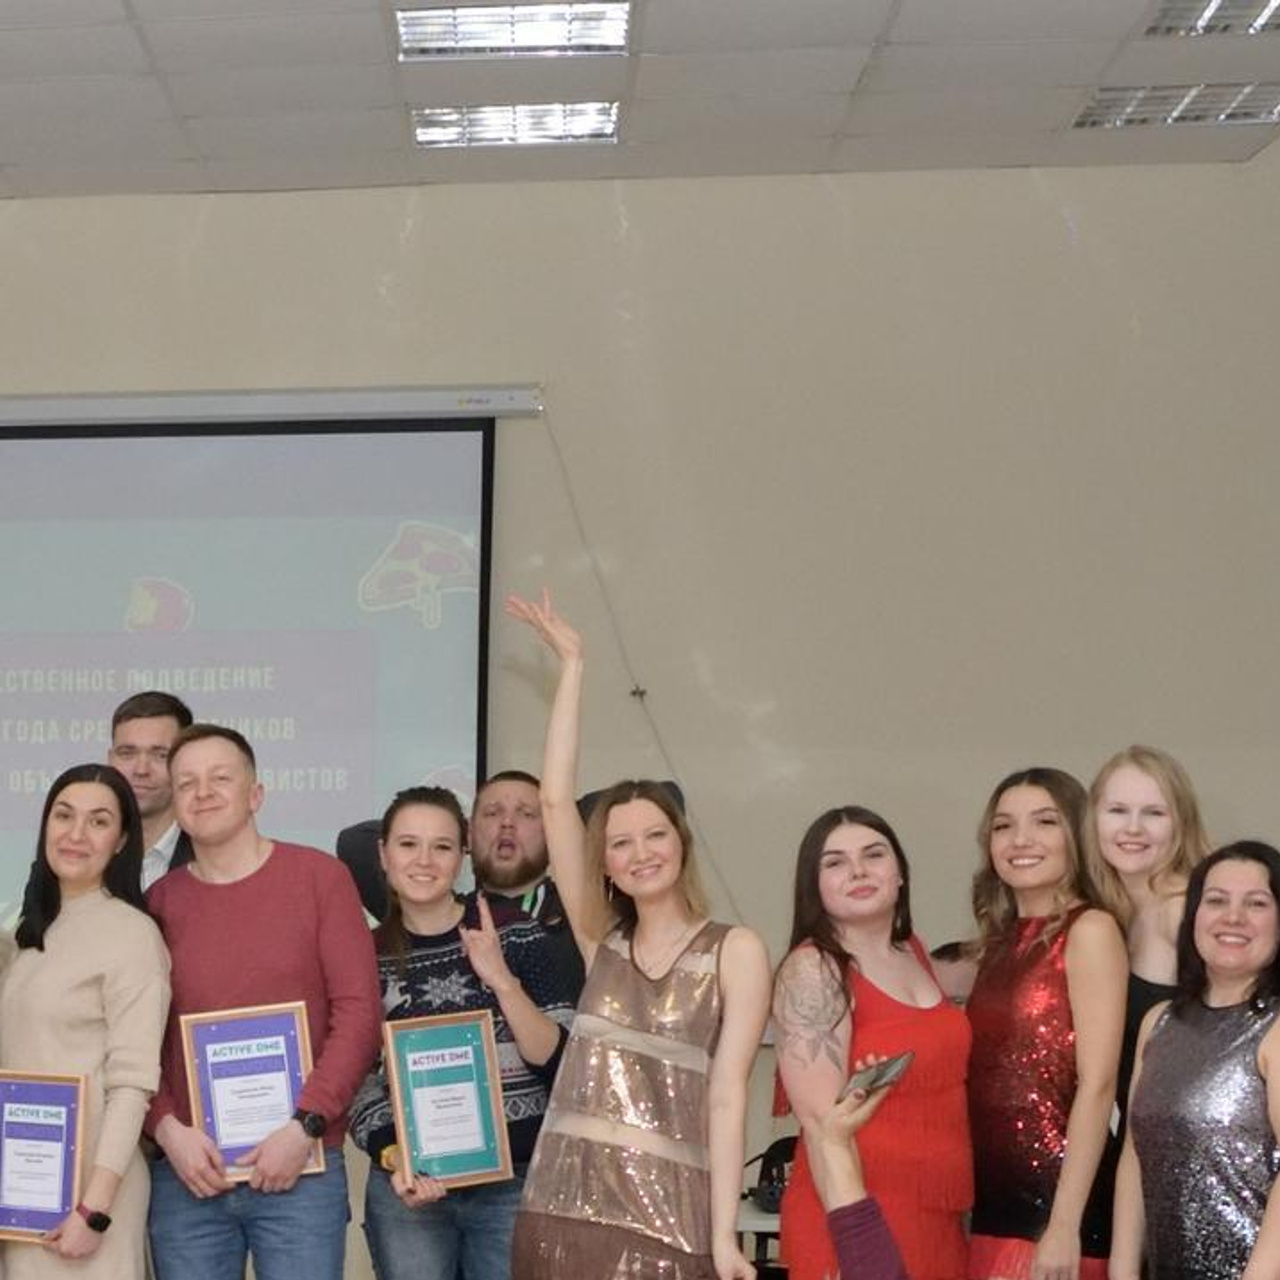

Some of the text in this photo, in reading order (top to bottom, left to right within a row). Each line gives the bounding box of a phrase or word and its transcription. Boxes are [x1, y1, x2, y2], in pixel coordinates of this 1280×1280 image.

[127, 666, 275, 690] ПОДВЕДЕНИЕ
[2, 719, 60, 743] ГОДА
[212, 1044, 253, 1057] ACTIVE
[412, 1055, 447, 1067] ACTIVE
[8, 1107, 41, 1119] ACTIVE
